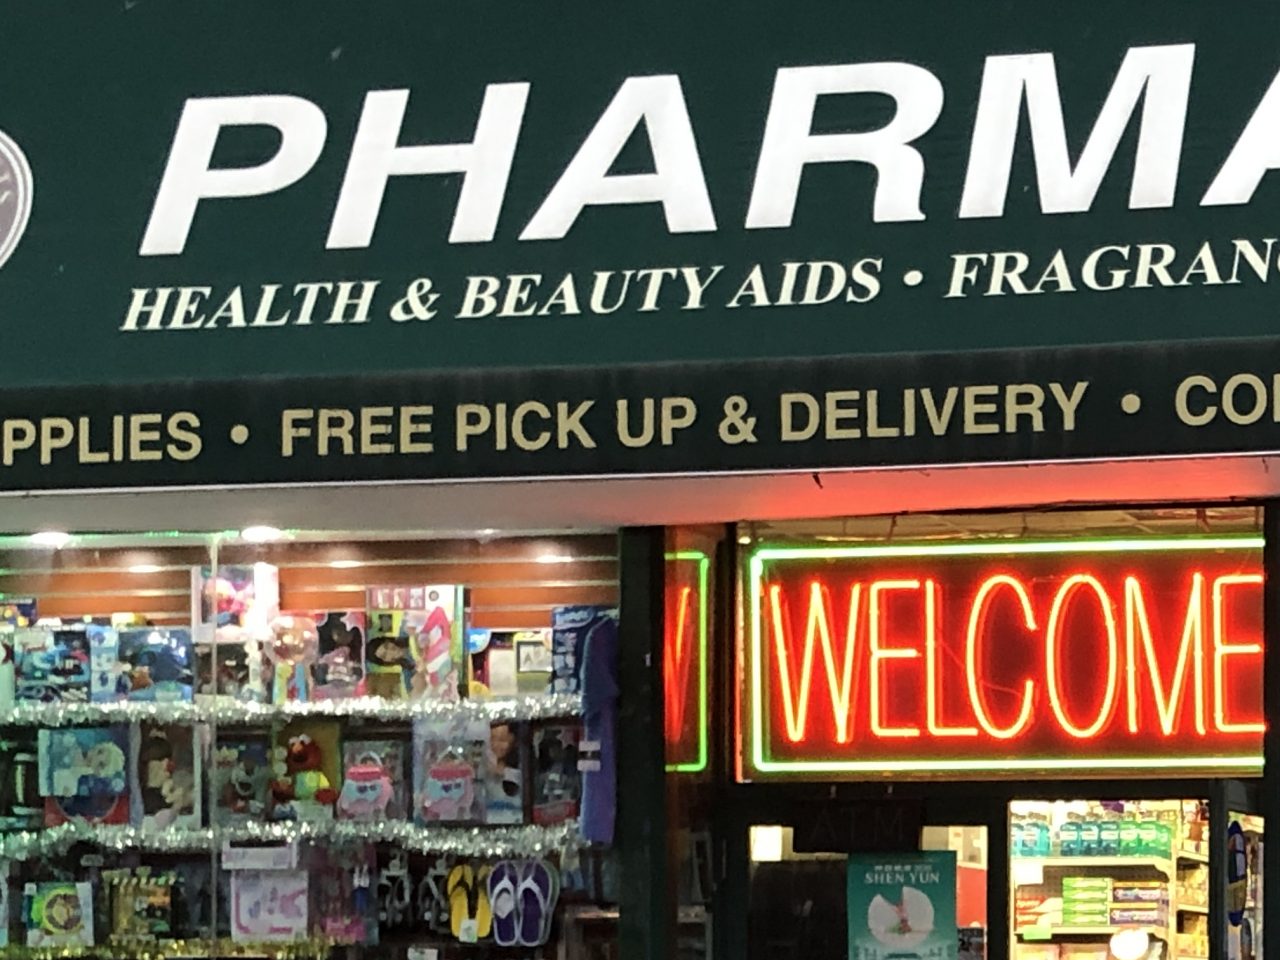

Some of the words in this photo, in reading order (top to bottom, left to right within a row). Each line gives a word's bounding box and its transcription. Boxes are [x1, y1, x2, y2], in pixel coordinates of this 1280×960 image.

[119, 279, 379, 332] HEALTH
[390, 276, 440, 325] &
[455, 264, 724, 320] BEAUTY
[726, 256, 883, 310] AIDS
[281, 406, 434, 457] FREE
[456, 399, 597, 453] PICK
[615, 396, 697, 448] UP
[718, 395, 757, 445] &
[780, 380, 1089, 442] DELIVERY
[769, 571, 1267, 743] WELCOME
[864, 871, 905, 884] SHEN
[909, 871, 941, 884] YUN
